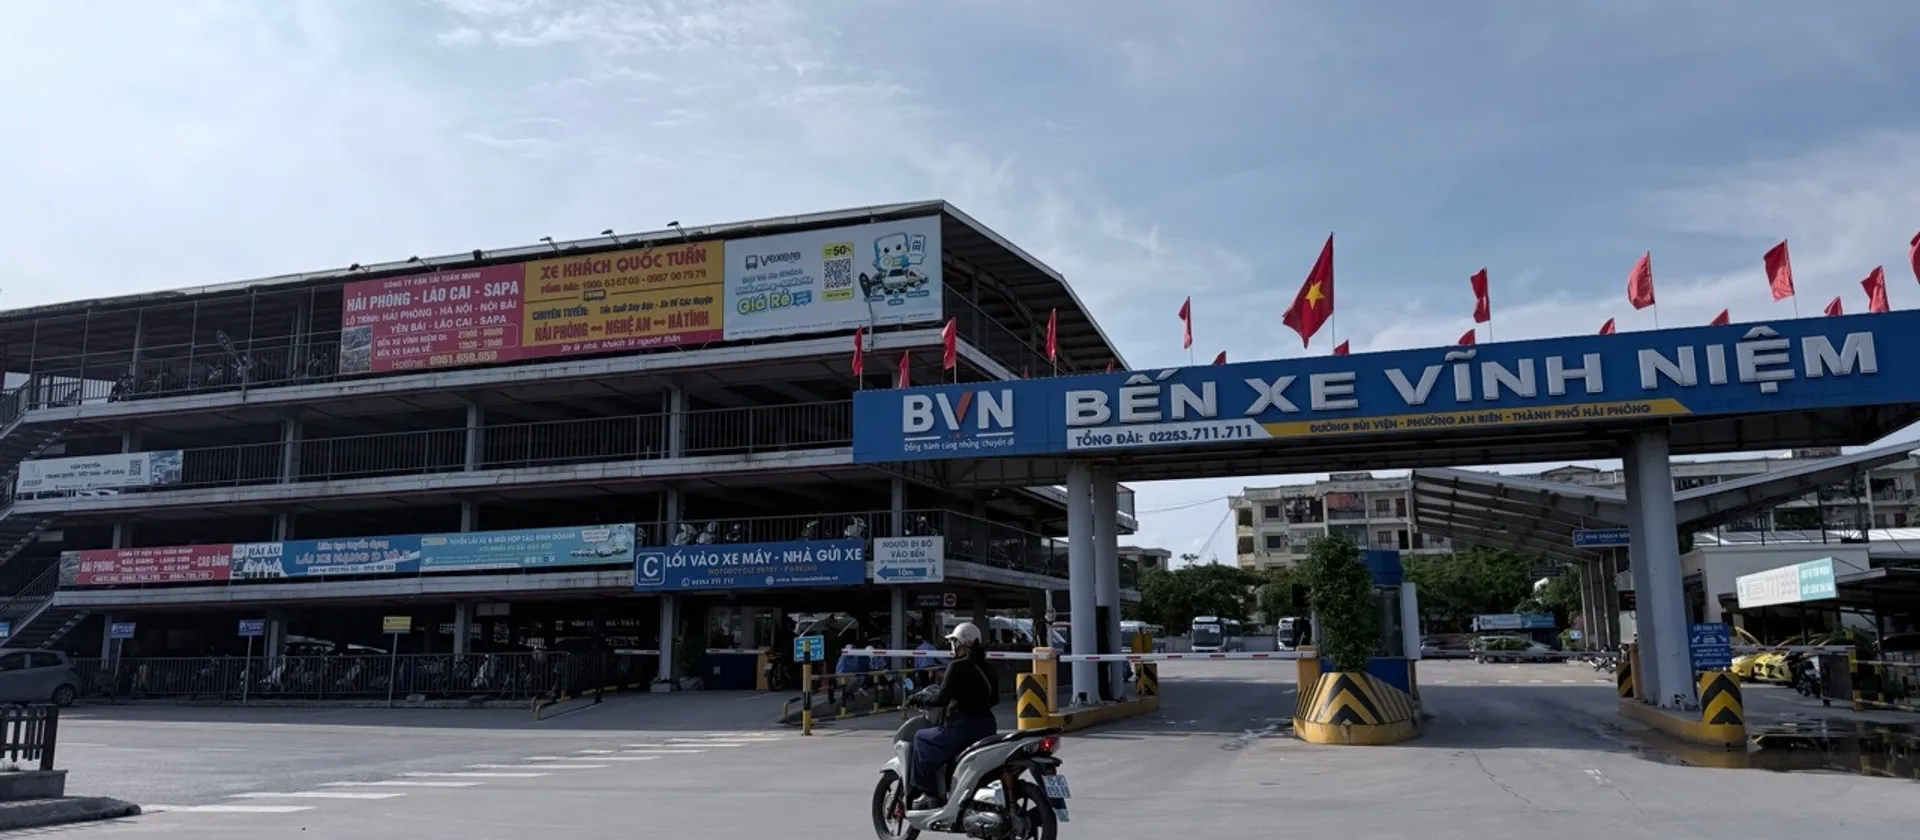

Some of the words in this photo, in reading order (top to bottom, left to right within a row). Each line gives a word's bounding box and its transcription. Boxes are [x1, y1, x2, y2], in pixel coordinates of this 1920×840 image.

[541, 265, 559, 280] XE
[563, 257, 611, 277] KHÁCH
[616, 250, 662, 273] QUỐC
[667, 244, 706, 266] TUẤN
[760, 252, 801, 266] Vexere
[347, 292, 366, 311] HẢI
[369, 290, 411, 309] PHÒNG
[423, 286, 446, 303] LÀO
[450, 285, 471, 300] CAI
[484, 280, 519, 297] SAPA
[382, 309, 398, 321] HẢI
[401, 308, 432, 319] PHÒNG
[440, 304, 453, 315] HÀ
[456, 303, 472, 316] NỘI
[480, 301, 498, 313] NỘI
[533, 307, 561, 320] CHUYÊN
[391, 321, 409, 333] YÊN
[456, 318, 472, 327] CAI
[480, 315, 506, 325] SAPA
[535, 322, 551, 341] HẢI
[553, 320, 588, 339] PHÒNG
[605, 315, 633, 335] NGHỆ
[635, 316, 651, 331] AN
[668, 311, 682, 329] HÀ
[684, 310, 709, 327] TĨNH
[602, 337, 625, 349] khách
[1066, 368, 1218, 427] BẾN
[1243, 371, 1359, 416] XE
[1383, 348, 1603, 405] VĨNH
[1638, 326, 1878, 394] NIỆM
[903, 388, 1013, 434] BVN
[1310, 421, 1349, 433] ĐƯỜNG
[1353, 421, 1370, 431] BÙI
[1373, 418, 1398, 432] VIỆN
[1407, 416, 1455, 427] PHƯỜNG
[1459, 415, 1474, 425] AN
[1479, 412, 1503, 423] BIÊN
[1512, 408, 1551, 421] THÀNH
[1555, 405, 1579, 418] PHỐ
[1583, 405, 1603, 417] HẢI
[1607, 402, 1651, 415] PHÒNG
[923, 439, 940, 450] hành
[941, 440, 958, 451] cùng
[1007, 437, 1014, 446] đi
[1076, 429, 1112, 446] TỔNG
[1117, 430, 1143, 445] ĐÀI:
[1149, 424, 1252, 442] 02253.711.711
[881, 539, 908, 549] NGƯỜI
[921, 538, 933, 549] BỘ
[643, 556, 659, 577] C
[666, 549, 686, 568] LỐI
[690, 550, 719, 567] VÀO
[723, 553, 739, 565] XE
[742, 548, 772, 565] MÁY
[783, 547, 812, 563] NHÀ
[817, 544, 841, 562] GỬI
[845, 548, 862, 561] XE
[784, 564, 818, 573] PARKING
